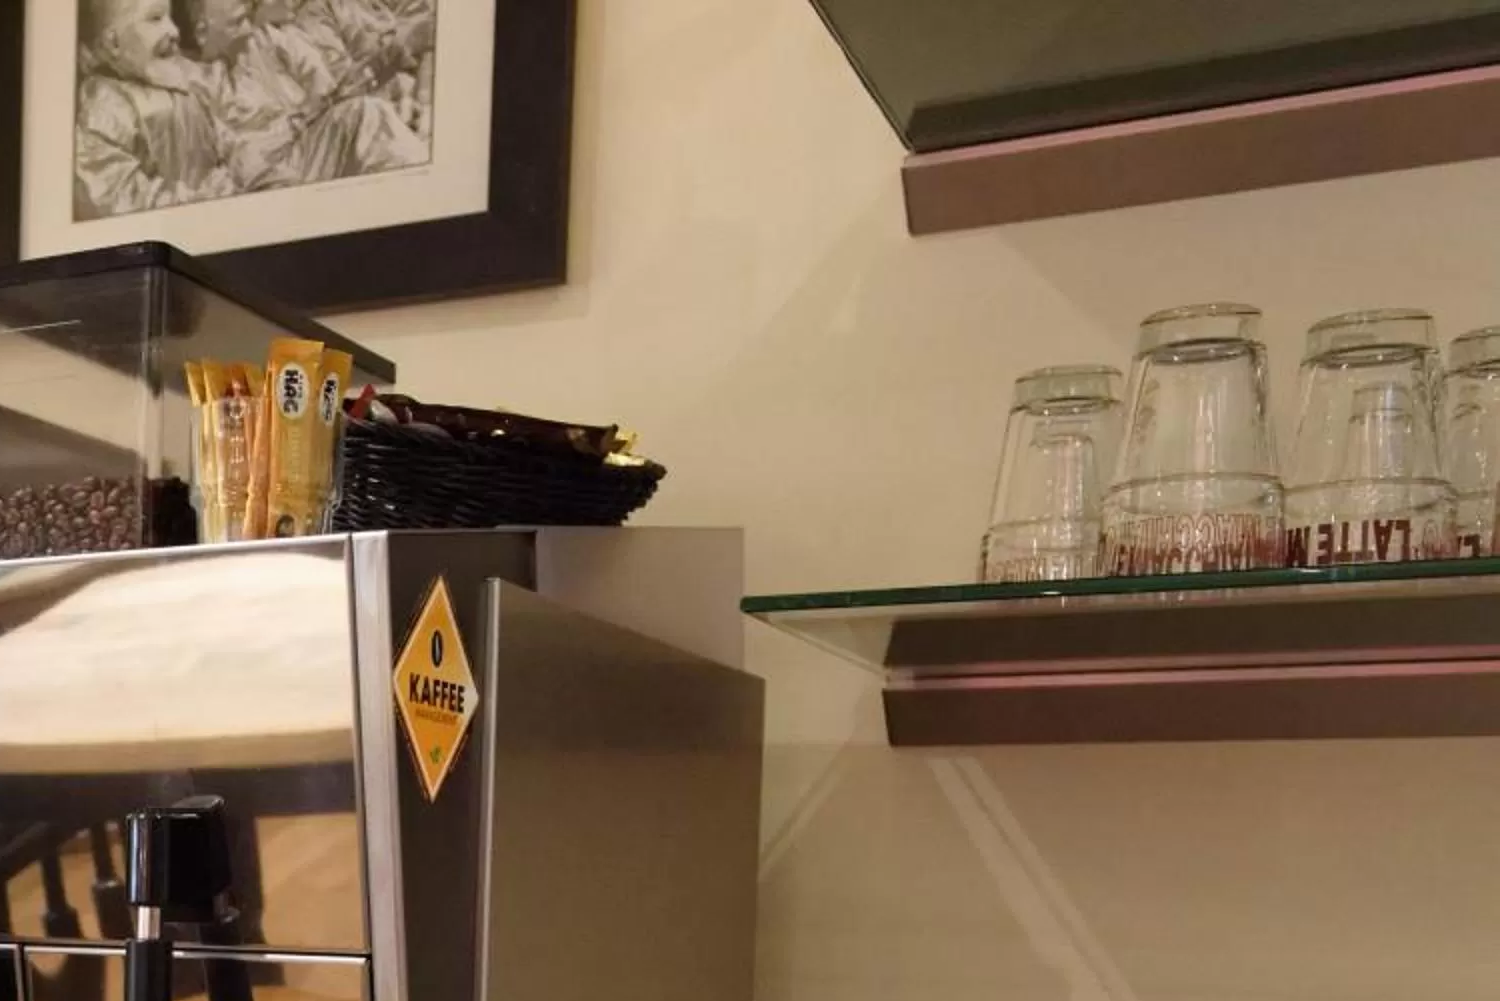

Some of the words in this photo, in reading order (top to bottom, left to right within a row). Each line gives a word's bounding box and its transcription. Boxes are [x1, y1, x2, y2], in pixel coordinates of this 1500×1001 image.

[283, 369, 299, 414] HAG
[1317, 519, 1411, 565] LATTE
[409, 672, 465, 714] KAFFEE
